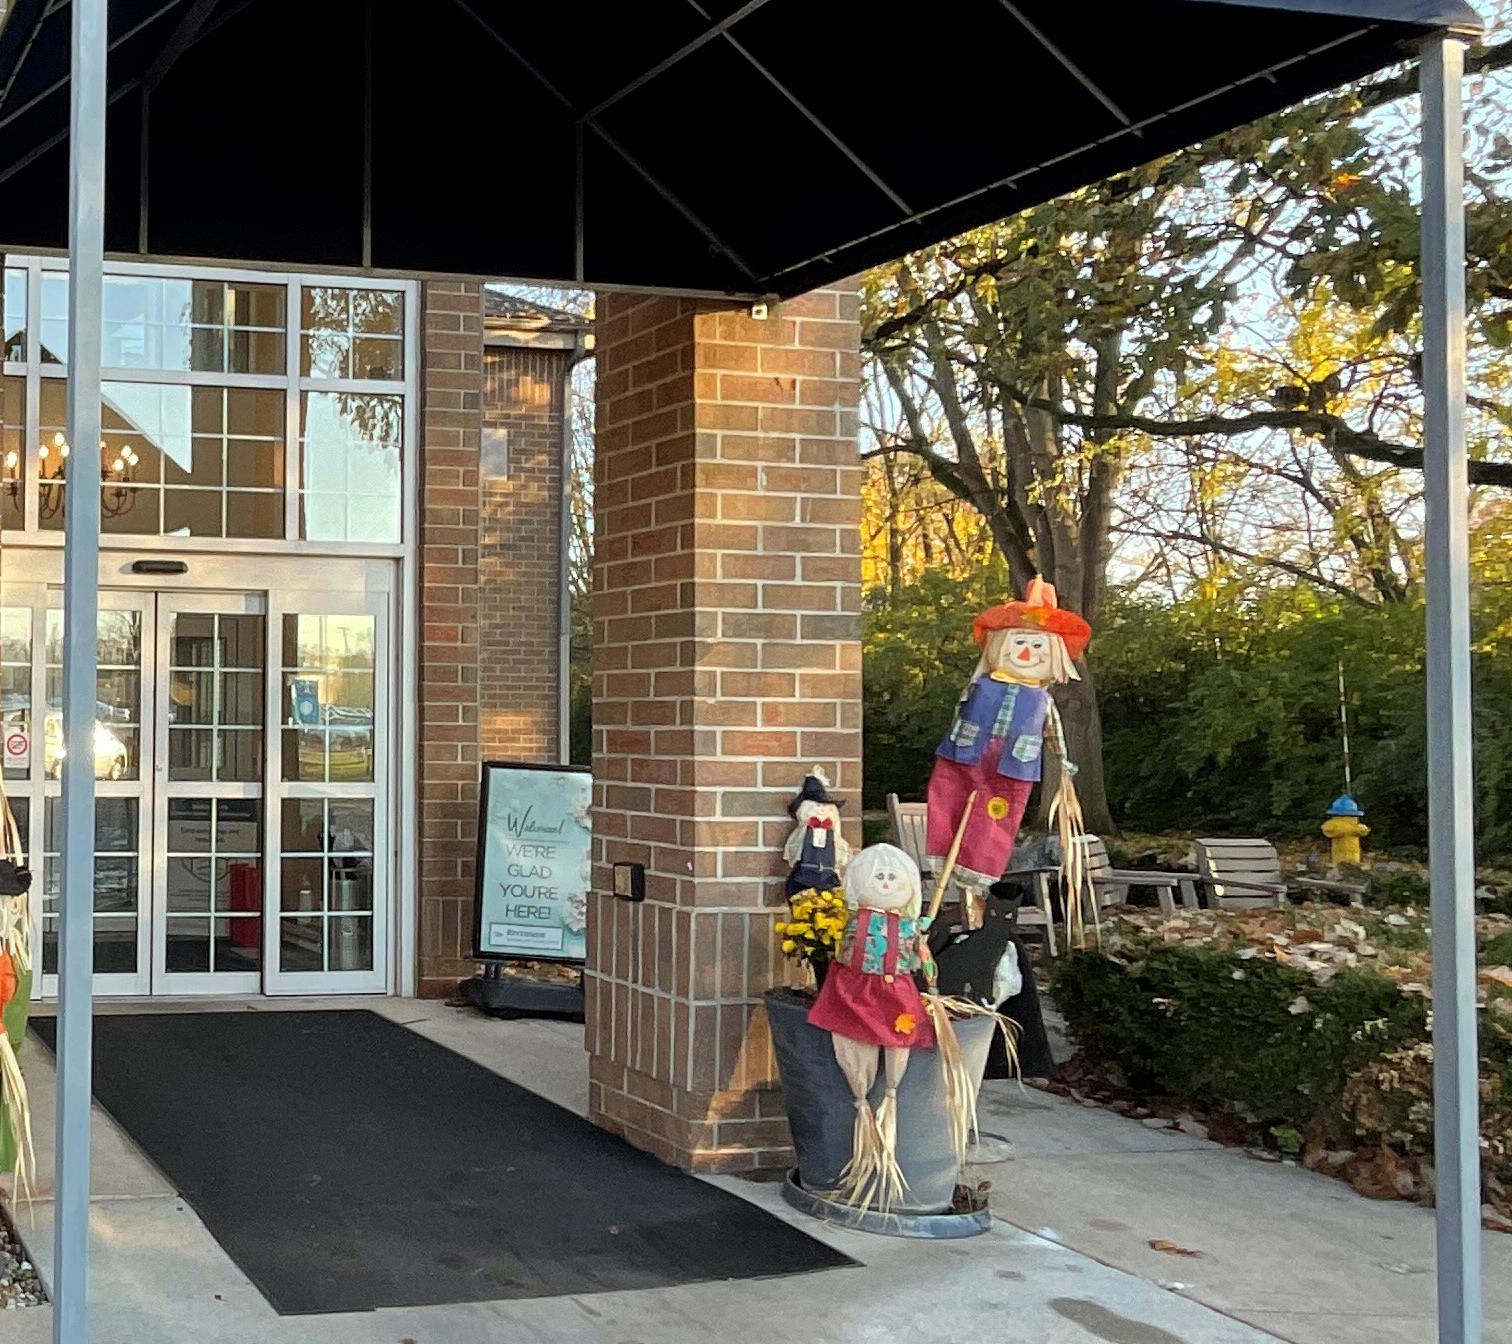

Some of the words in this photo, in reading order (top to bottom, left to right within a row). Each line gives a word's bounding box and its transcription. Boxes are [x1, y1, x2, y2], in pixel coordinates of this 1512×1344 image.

[507, 863, 552, 879] GLAD
[499, 882, 559, 901] YOU'RE
[505, 903, 551, 920] HERE!
